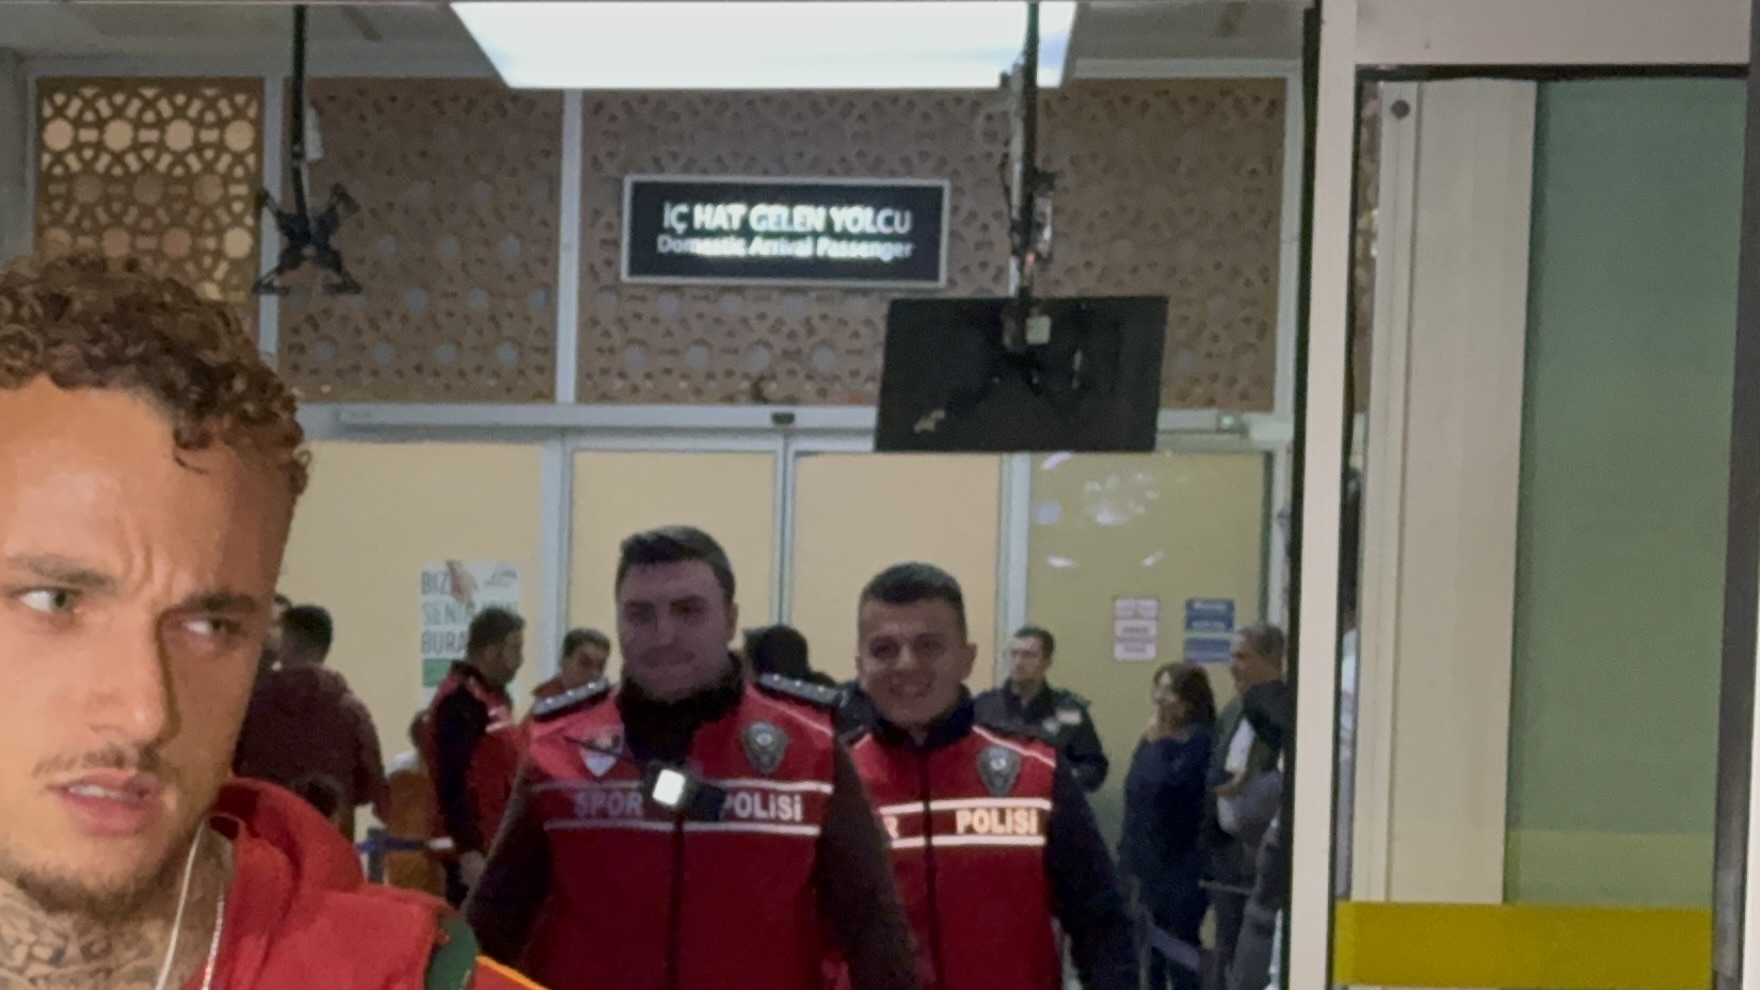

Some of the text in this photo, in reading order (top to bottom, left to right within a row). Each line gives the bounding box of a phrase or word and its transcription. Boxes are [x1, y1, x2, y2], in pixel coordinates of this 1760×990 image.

[663, 201, 912, 235] İÇ HAT GELEN YOLCU
[748, 235, 813, 258] Arrival
[816, 236, 915, 262] Passenger
[575, 789, 644, 817] SPOR
